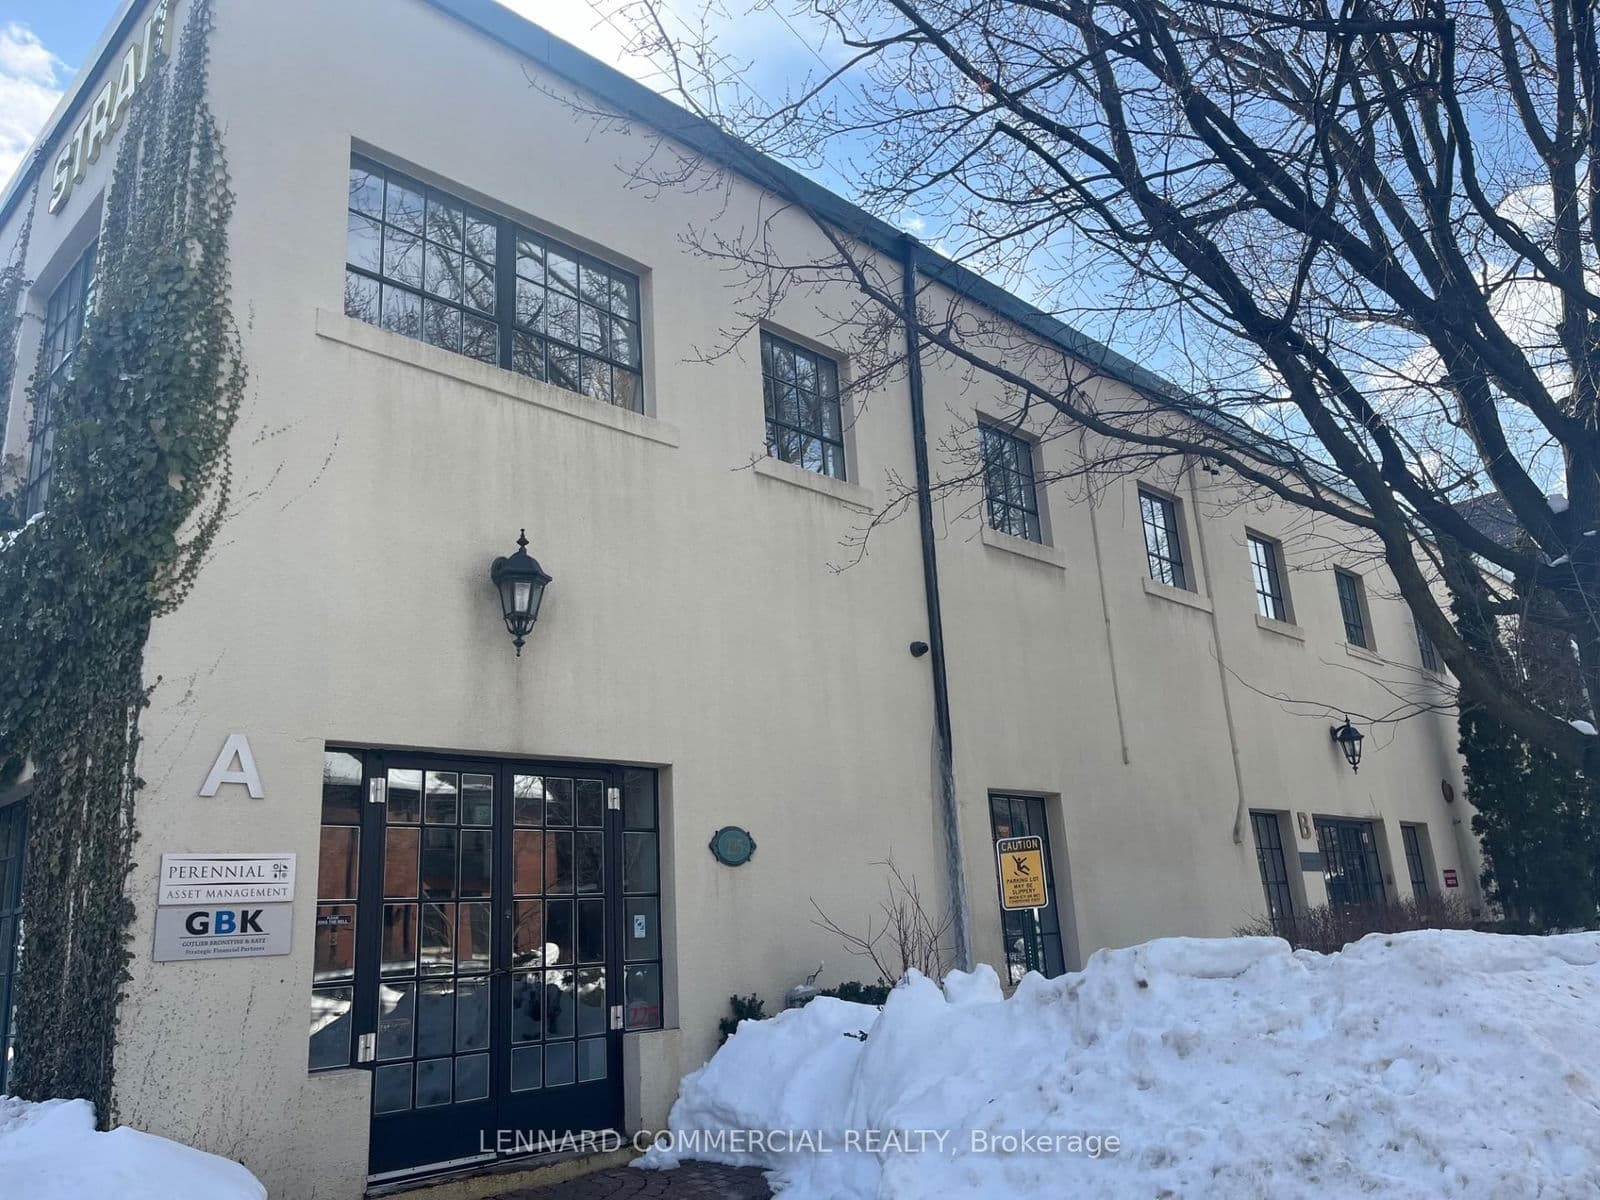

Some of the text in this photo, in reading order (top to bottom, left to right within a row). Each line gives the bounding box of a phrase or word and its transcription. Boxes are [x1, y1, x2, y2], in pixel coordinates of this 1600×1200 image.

[200, 733, 264, 799] A
[1296, 811, 1312, 840] B
[1001, 839, 1038, 852] CAUTION
[168, 865, 265, 879] PERENNIAL
[166, 887, 289, 899] ASSET MANAGEMENT
[1011, 888, 1036, 896] SLIPPERY
[185, 909, 264, 936] GBK
[185, 948, 211, 956] Strategic
